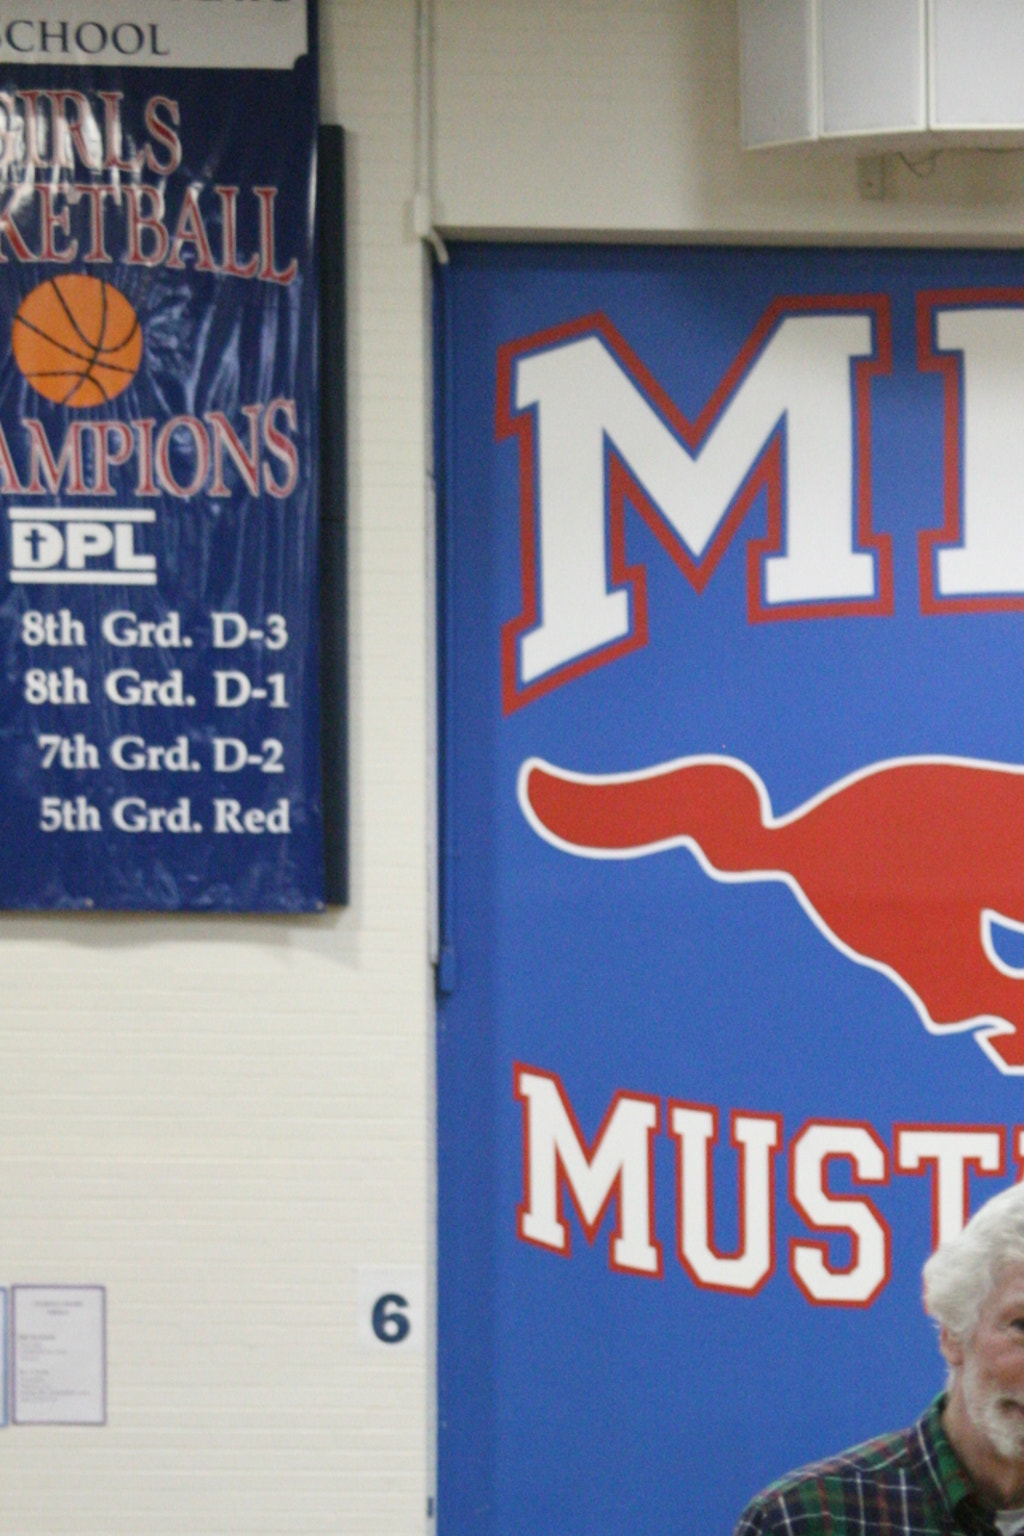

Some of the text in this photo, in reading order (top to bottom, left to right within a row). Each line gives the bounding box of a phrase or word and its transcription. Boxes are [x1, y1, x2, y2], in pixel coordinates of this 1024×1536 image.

[0, 19, 170, 56] CHOOL
[11, 521, 157, 571] DPL
[21, 609, 288, 651] 8th Grd. D-3
[24, 667, 290, 709] 8th Grd. D-1
[38, 734, 285, 774] 7th Grd. D-2
[39, 796, 292, 835] 5th Grd. Red
[371, 1293, 412, 1344] 6
